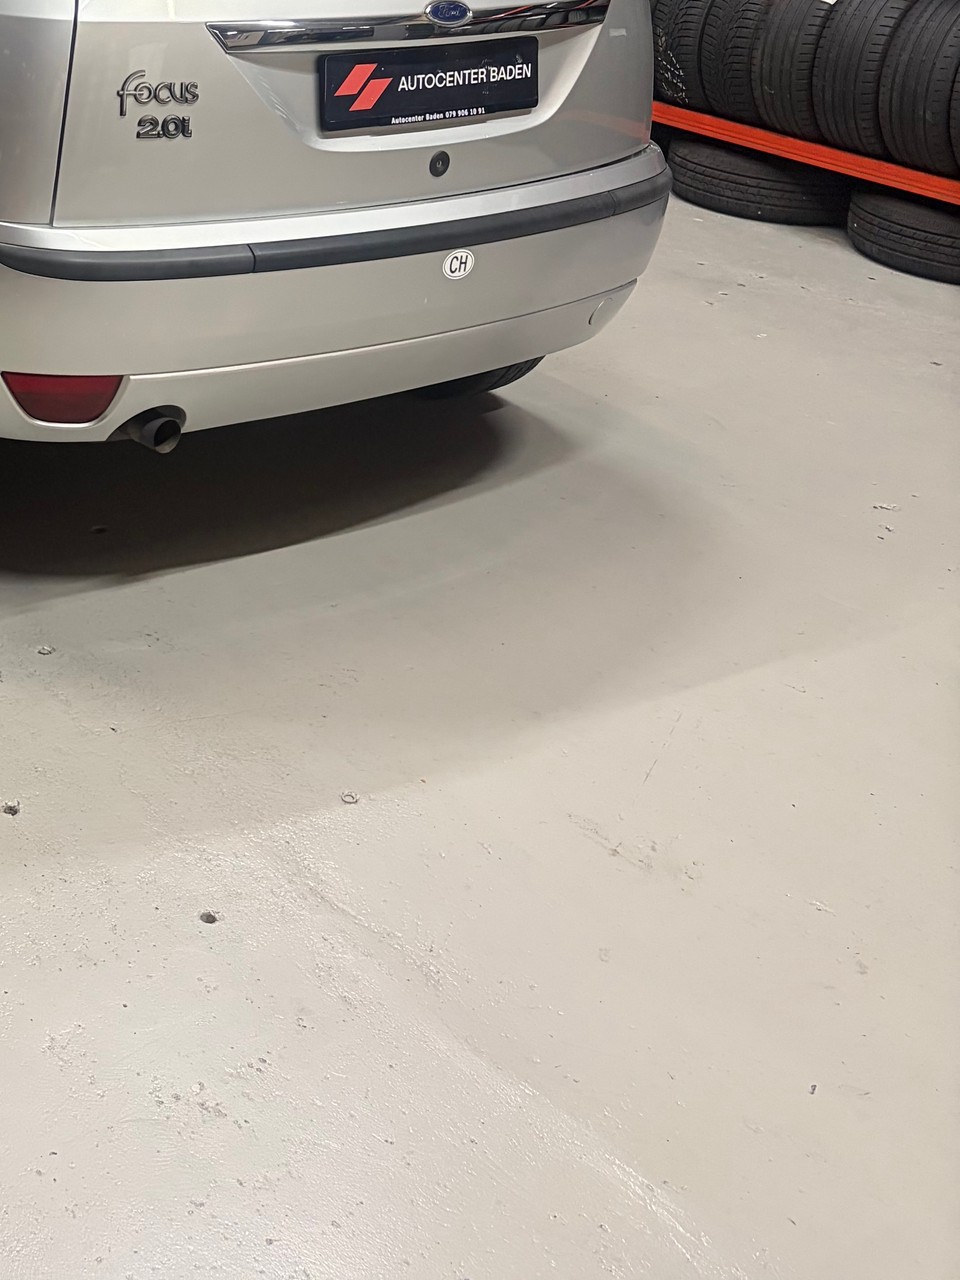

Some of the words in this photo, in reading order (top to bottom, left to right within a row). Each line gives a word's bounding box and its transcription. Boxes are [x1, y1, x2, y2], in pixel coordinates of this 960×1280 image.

[397, 68, 487, 92] AUTOCENTER
[489, 63, 532, 82] BADEN
[391, 114, 424, 124] Autocenter
[426, 112, 444, 121] Baden
[445, 110, 456, 119] 079
[458, 108, 469, 117] 906
[470, 107, 477, 115] 10
[478, 106, 486, 114] 91
[449, 254, 469, 274] CH
